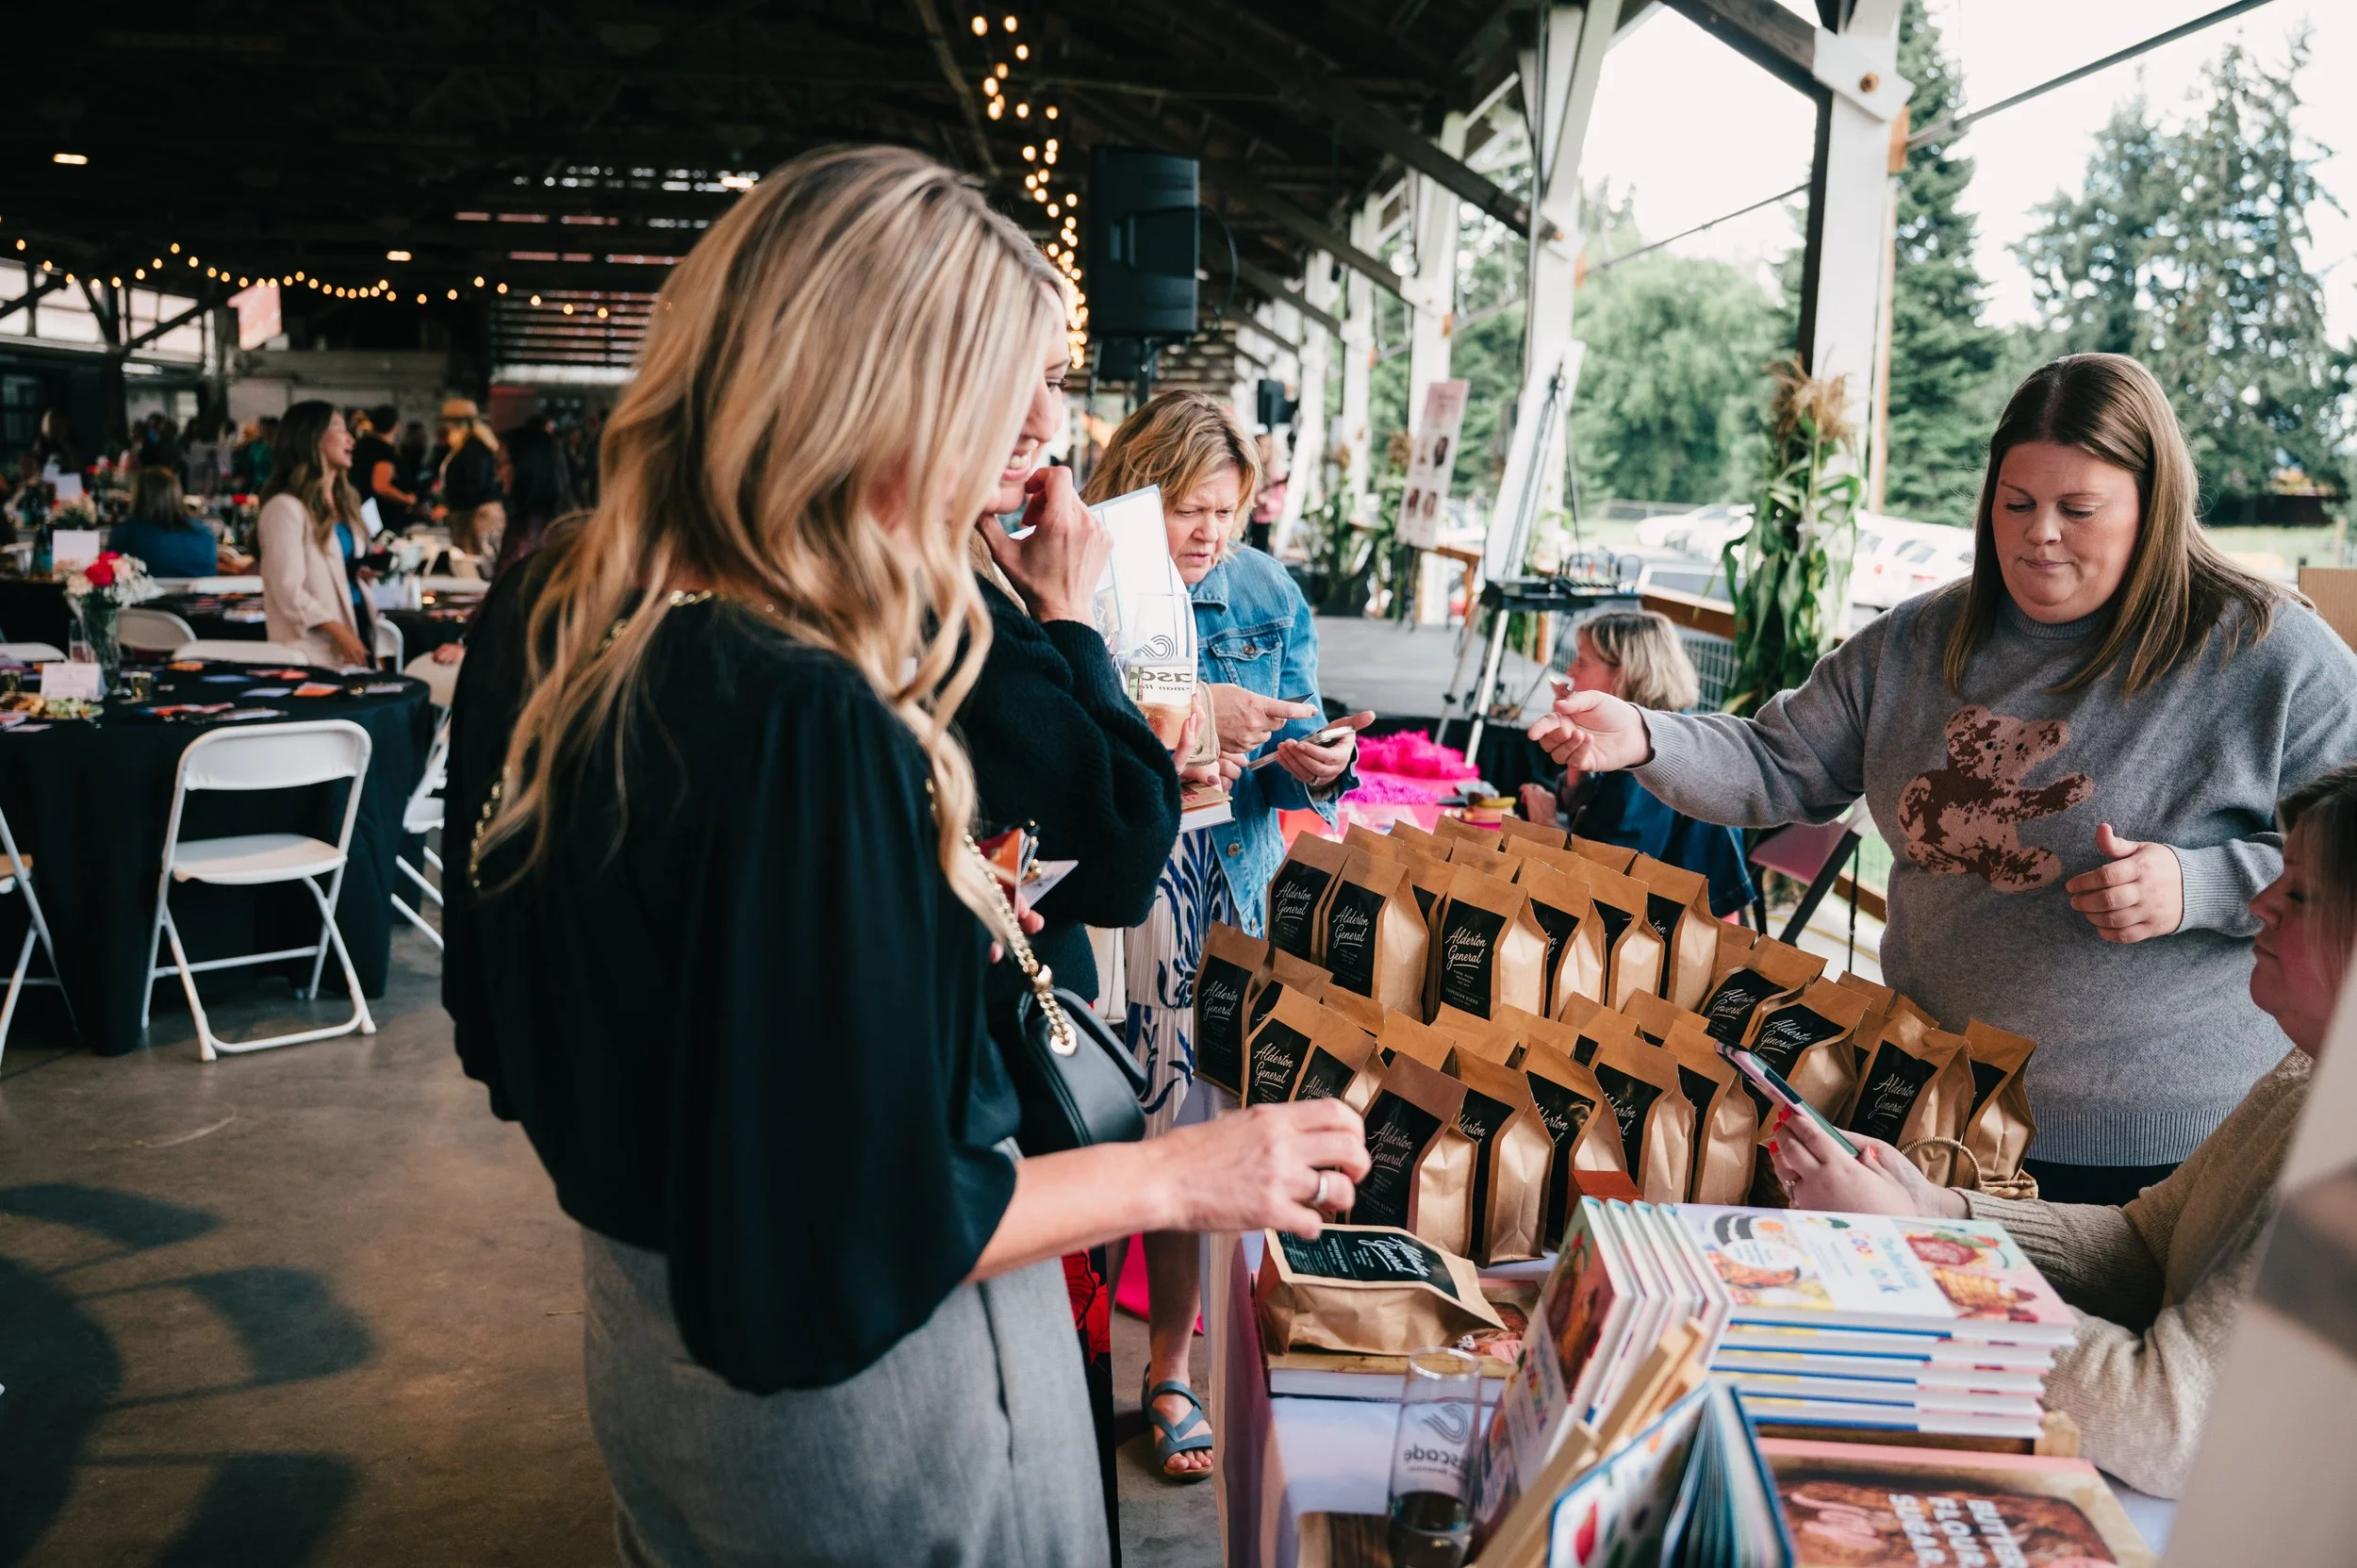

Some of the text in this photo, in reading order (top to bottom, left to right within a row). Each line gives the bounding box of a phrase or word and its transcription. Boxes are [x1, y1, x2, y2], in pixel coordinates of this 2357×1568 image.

[1276, 880, 1312, 901] Alderton
[1275, 898, 1310, 923] General
[1332, 905, 1370, 927] Alderton
[1333, 923, 1367, 949] General
[1444, 926, 1487, 948] Alderton
[1446, 944, 1485, 971] General
[1202, 980, 1239, 1001] Alderton
[1203, 998, 1236, 1022] General
[1754, 1030, 1805, 1053] General
[1253, 1042, 1294, 1069] Alderton
[1255, 1061, 1290, 1086] General
[1872, 1072, 1917, 1098] Alderton
[1868, 1093, 1911, 1119] General
[1367, 1121, 1413, 1150] Alderton
[1370, 1142, 1409, 1169] General
[1358, 1238, 1419, 1275] General
[1888, 1493, 1947, 1568] SUGAR
[1926, 1495, 1987, 1568] FLOUR
[1965, 1499, 2030, 1568] BUTTER
